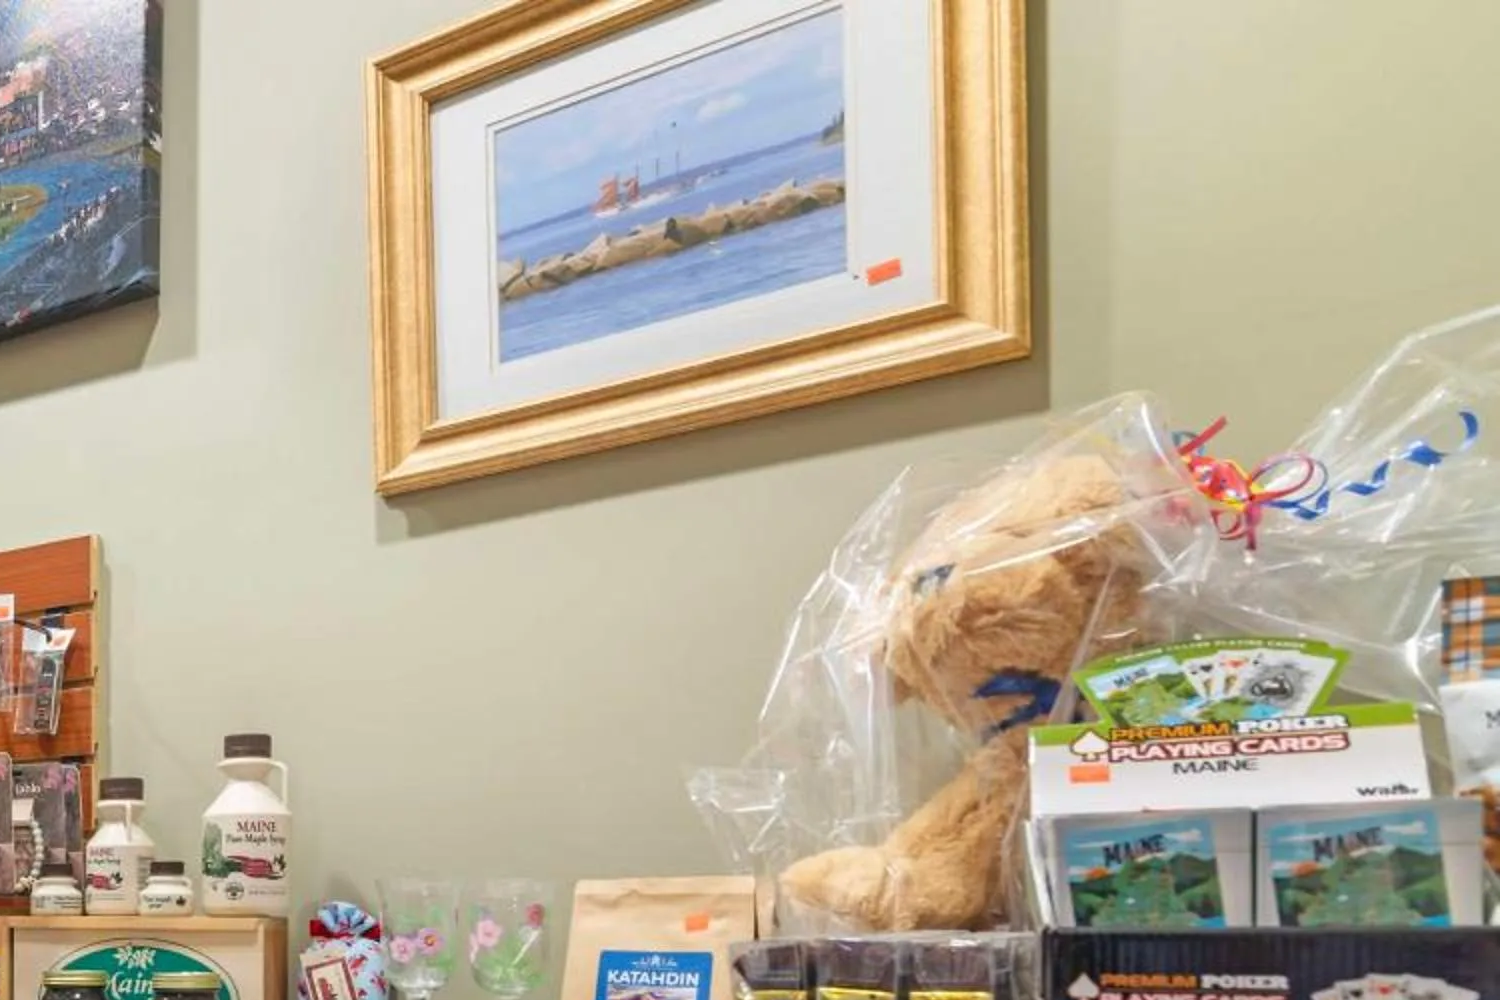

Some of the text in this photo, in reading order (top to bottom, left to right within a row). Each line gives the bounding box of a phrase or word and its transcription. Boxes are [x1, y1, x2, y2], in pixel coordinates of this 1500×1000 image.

[1111, 714, 1348, 741] PREMIUM POKER
[1110, 734, 1347, 761] PLAYING CARDS
[1173, 758, 1259, 774] MAINE
[237, 821, 276, 833] MAINE
[1102, 833, 1167, 867] MAINE
[1312, 826, 1384, 861] MAINE
[607, 969, 700, 987] KATAHDIN
[1100, 973, 1290, 990] PREMIUM POKER
